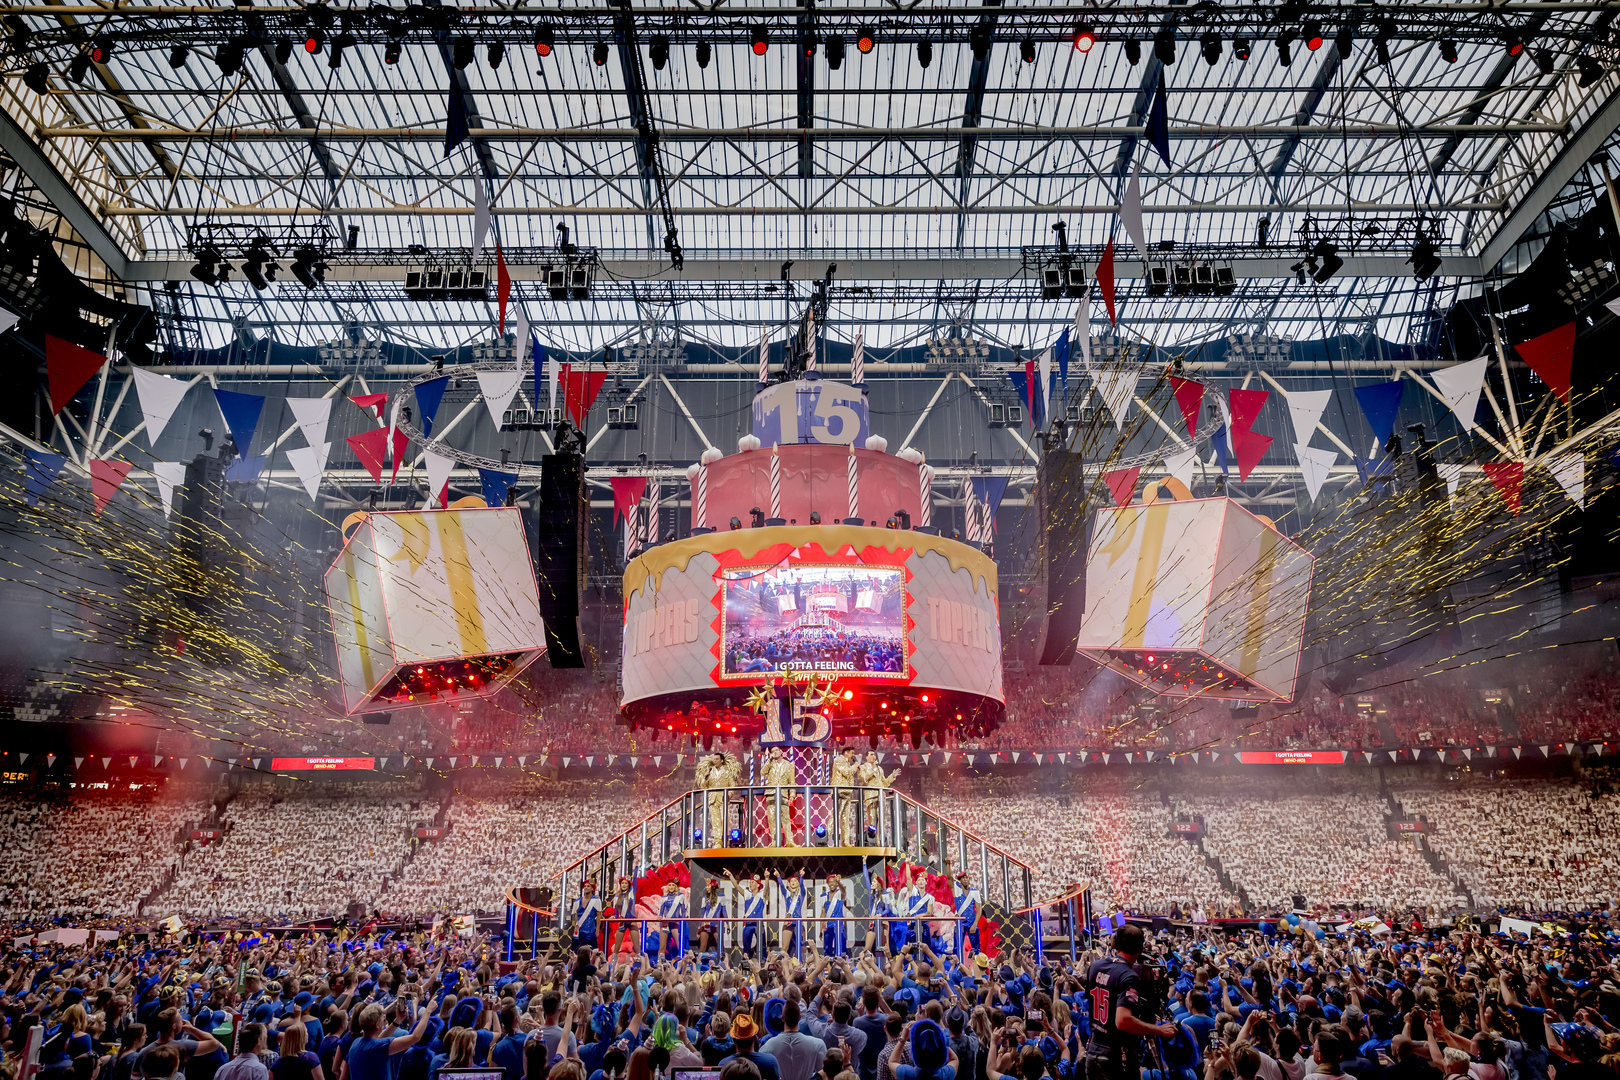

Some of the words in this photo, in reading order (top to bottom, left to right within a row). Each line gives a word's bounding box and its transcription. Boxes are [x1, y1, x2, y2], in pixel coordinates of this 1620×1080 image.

[762, 382, 862, 444] 15
[632, 598, 699, 657] TOPPERS
[775, 662, 778, 670] I
[780, 661, 813, 670] GOTTA
[815, 661, 854, 670] FEELING
[761, 698, 830, 742] 15
[1090, 986, 1110, 1025] 15
